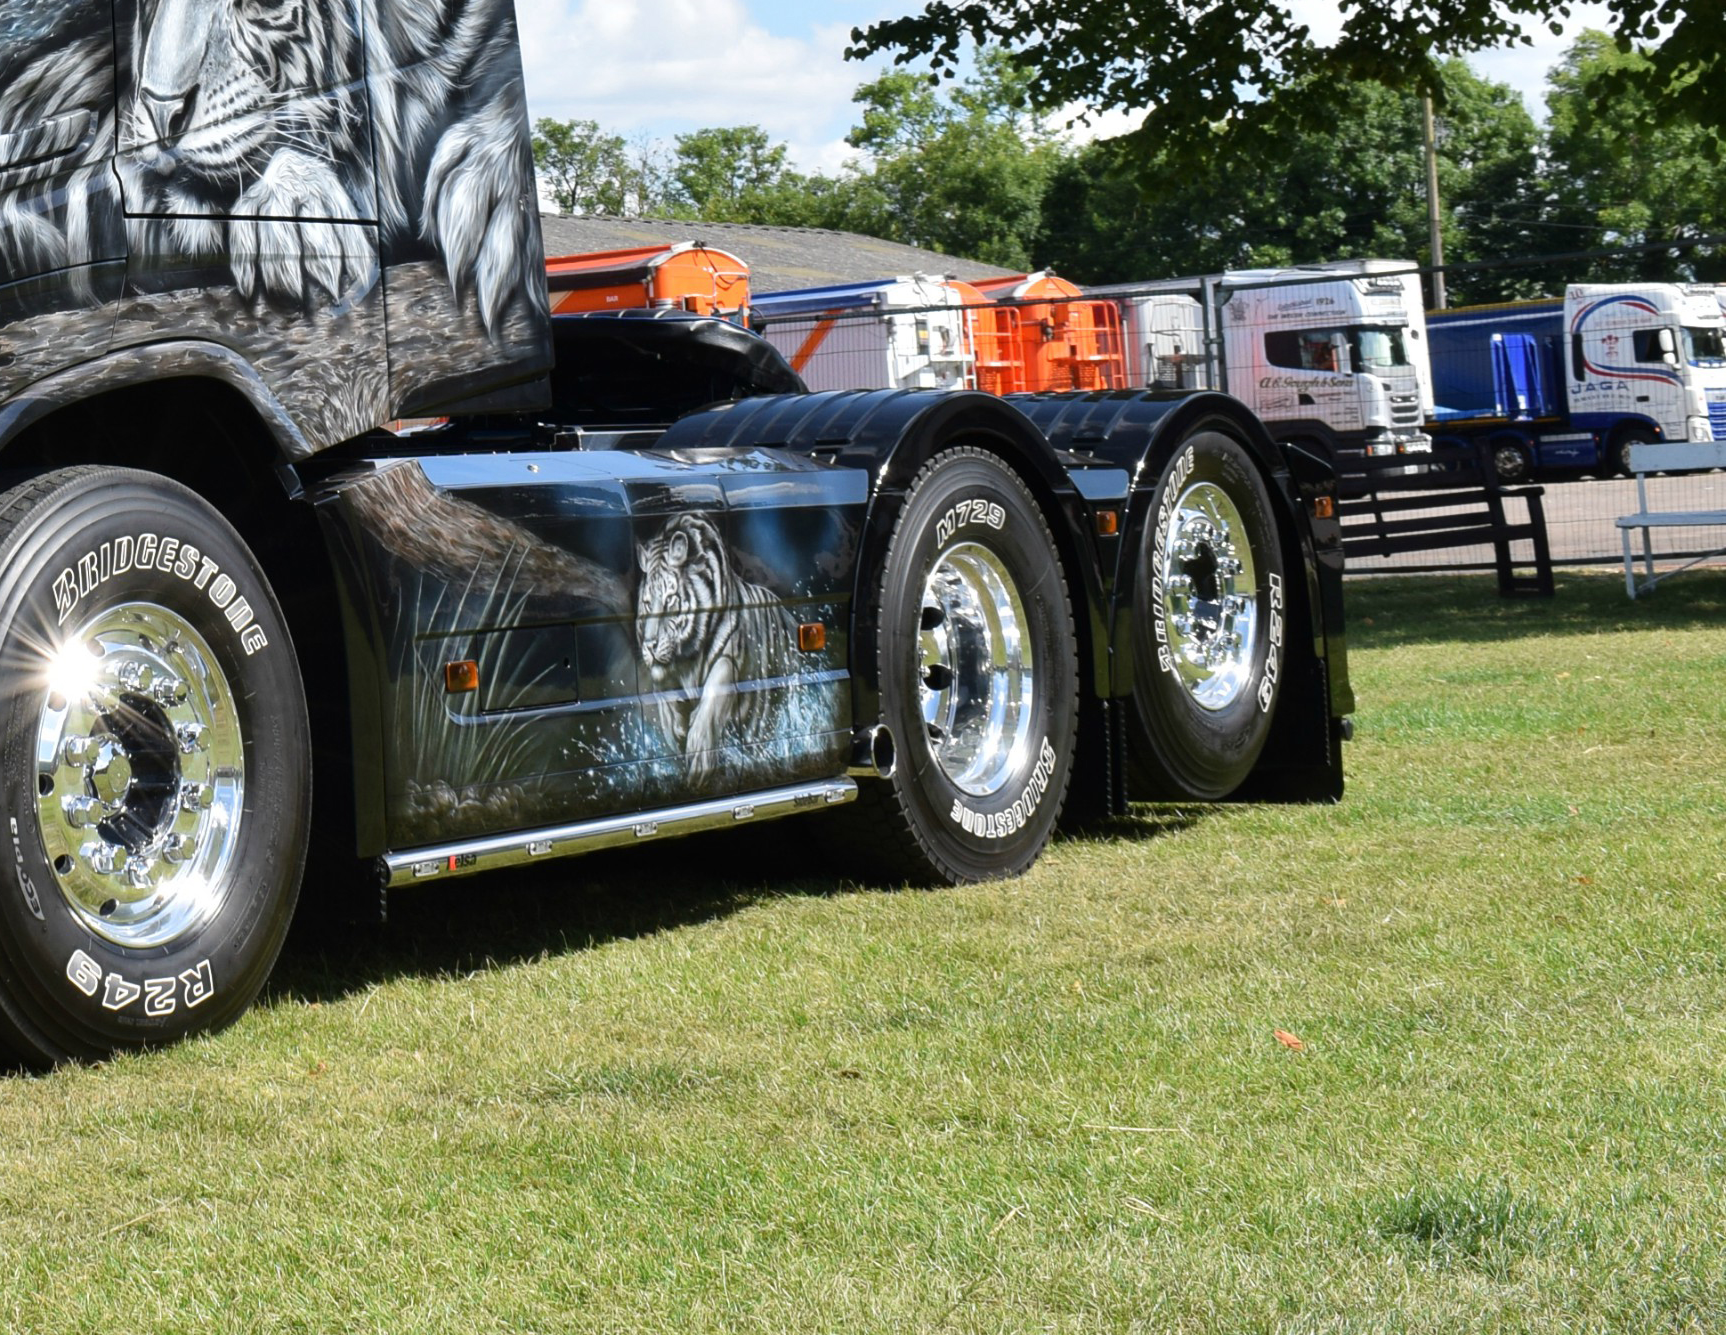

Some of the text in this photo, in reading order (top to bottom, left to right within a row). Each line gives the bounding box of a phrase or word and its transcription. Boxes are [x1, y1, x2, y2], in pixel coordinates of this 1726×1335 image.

[1571, 381, 1630, 394] JAGA
[936, 499, 1006, 550] M729
[1152, 445, 1195, 672] BRIDGESTONE
[52, 533, 268, 656] BRIDGESTONE
[1258, 572, 1284, 713] R249
[950, 735, 1056, 838] BRIDGESTONE
[66, 948, 214, 1017] R249
